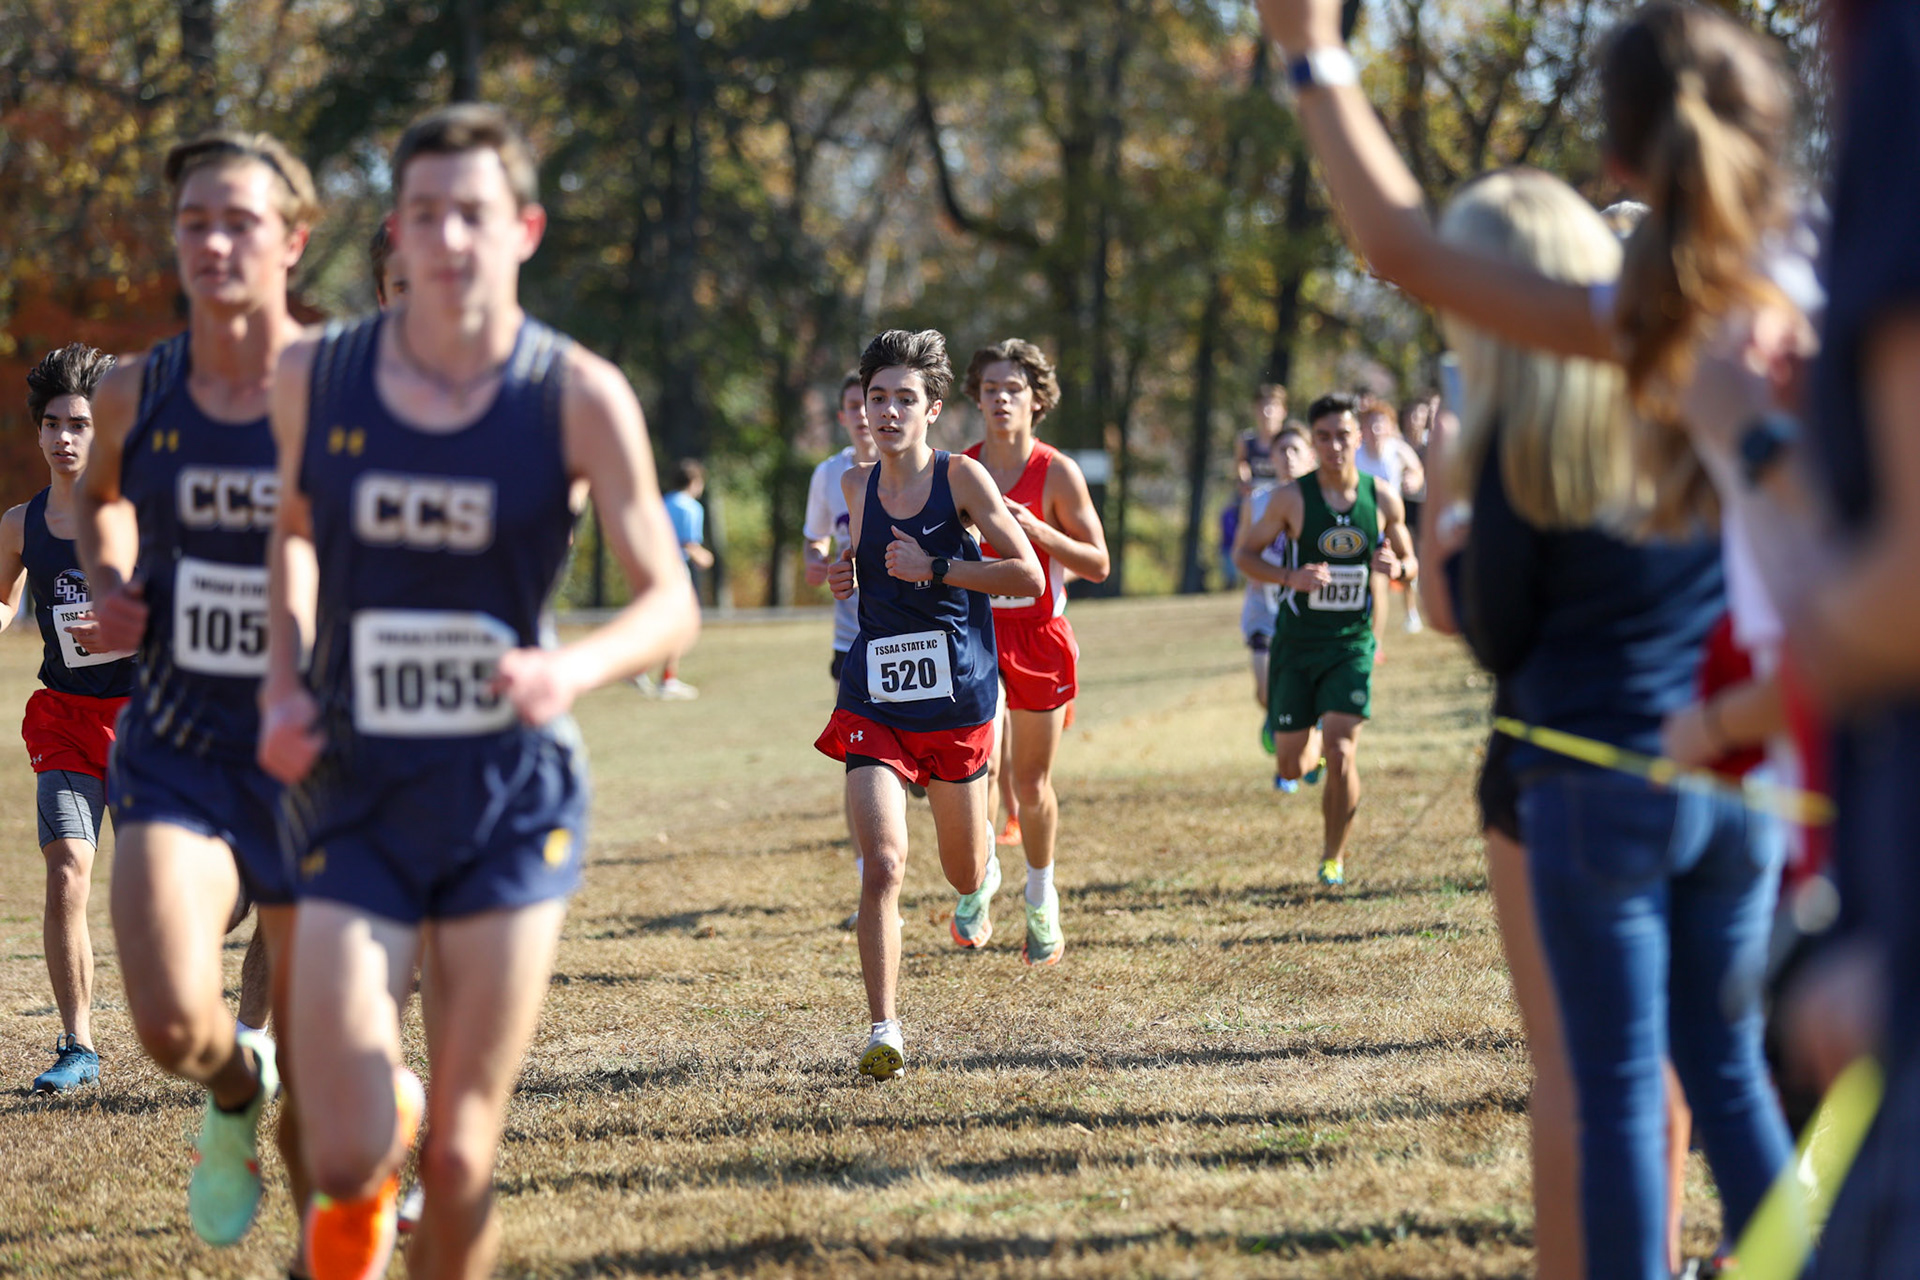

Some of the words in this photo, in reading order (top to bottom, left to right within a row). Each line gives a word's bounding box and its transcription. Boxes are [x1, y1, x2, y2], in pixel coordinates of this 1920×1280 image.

[178, 467, 281, 530] CCS
[353, 470, 497, 555] CCS
[1318, 583, 1360, 603] 1037
[186, 605, 268, 656] 105
[875, 644, 900, 656] TSSAA
[901, 640, 925, 652] STATE
[926, 639, 938, 649] XC
[370, 661, 502, 712] 1055
[880, 657, 938, 693] 520
